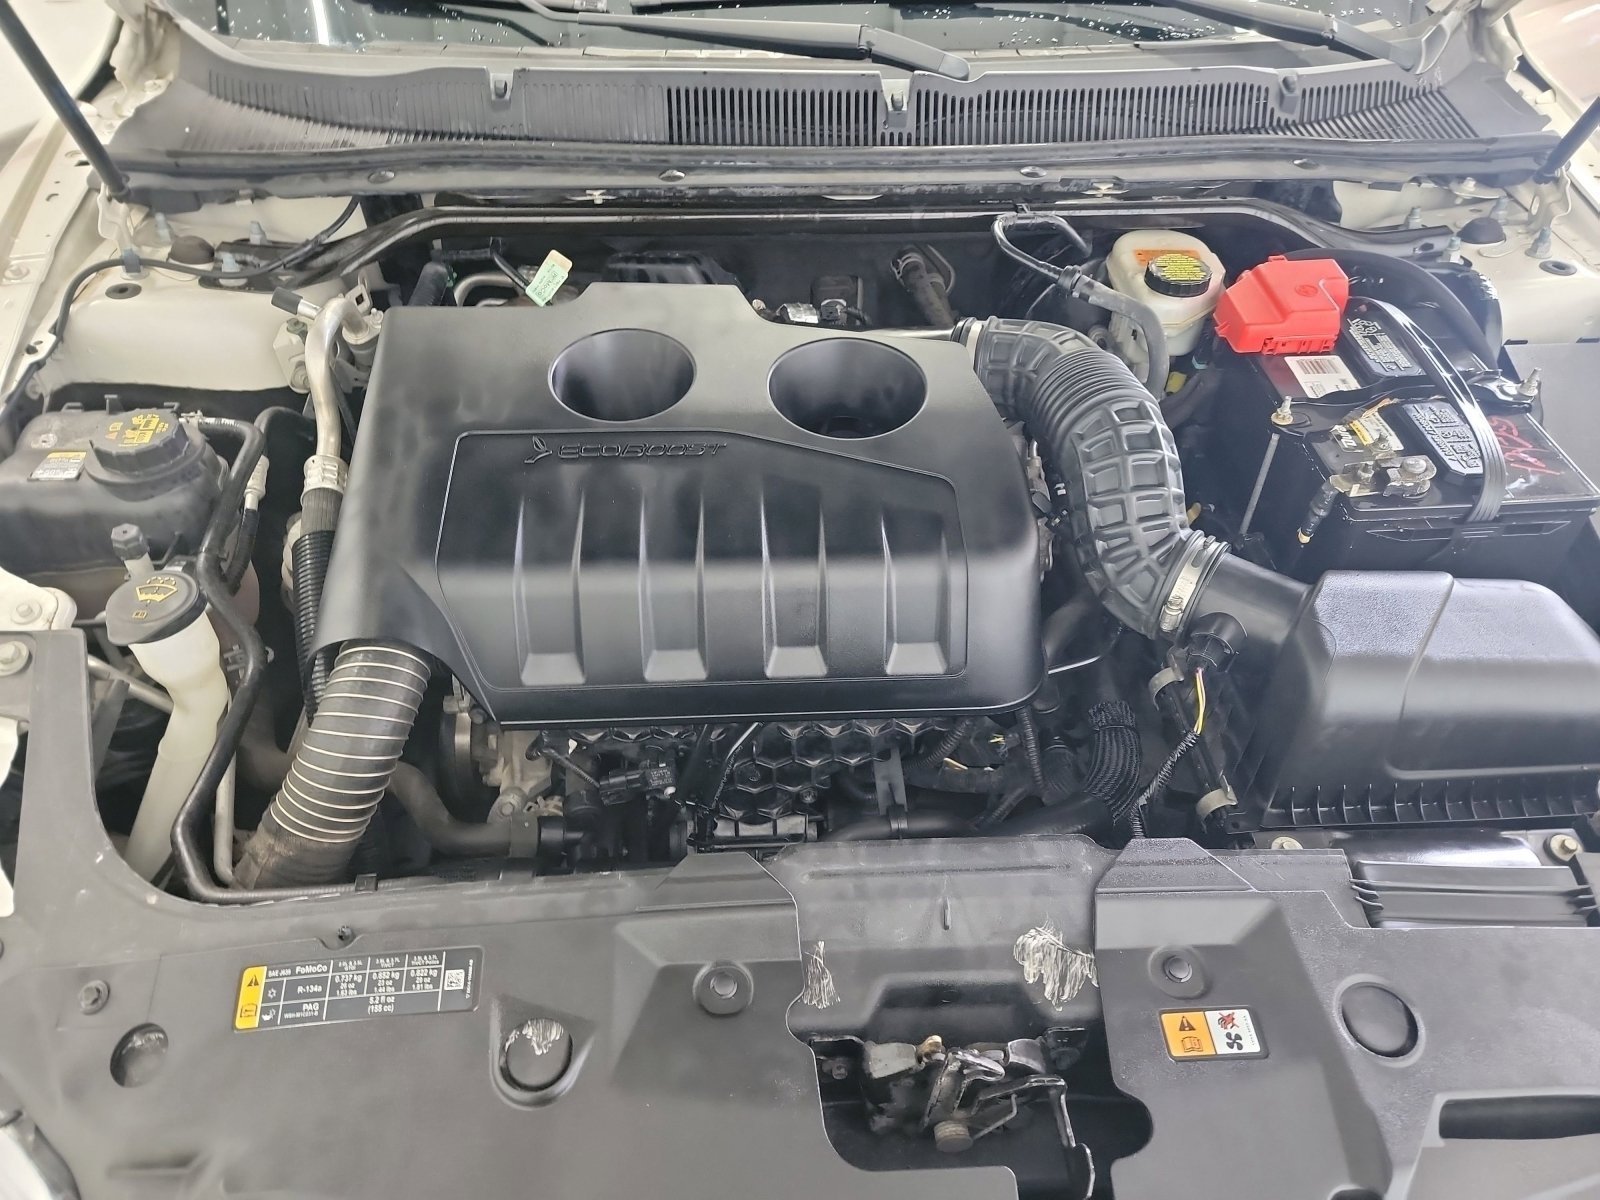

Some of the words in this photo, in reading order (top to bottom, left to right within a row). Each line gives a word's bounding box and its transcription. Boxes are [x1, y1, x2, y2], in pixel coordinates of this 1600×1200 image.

[558, 442, 728, 459] ECOBOOST
[295, 964, 328, 975] FoMoCo
[429, 968, 438, 977] kg
[335, 974, 353, 984] 0.737
[354, 974, 362, 983] kg
[391, 970, 400, 980] kg
[297, 984, 322, 994] R-134a
[369, 996, 380, 1005] 5.2
[302, 1002, 320, 1011] PAG
